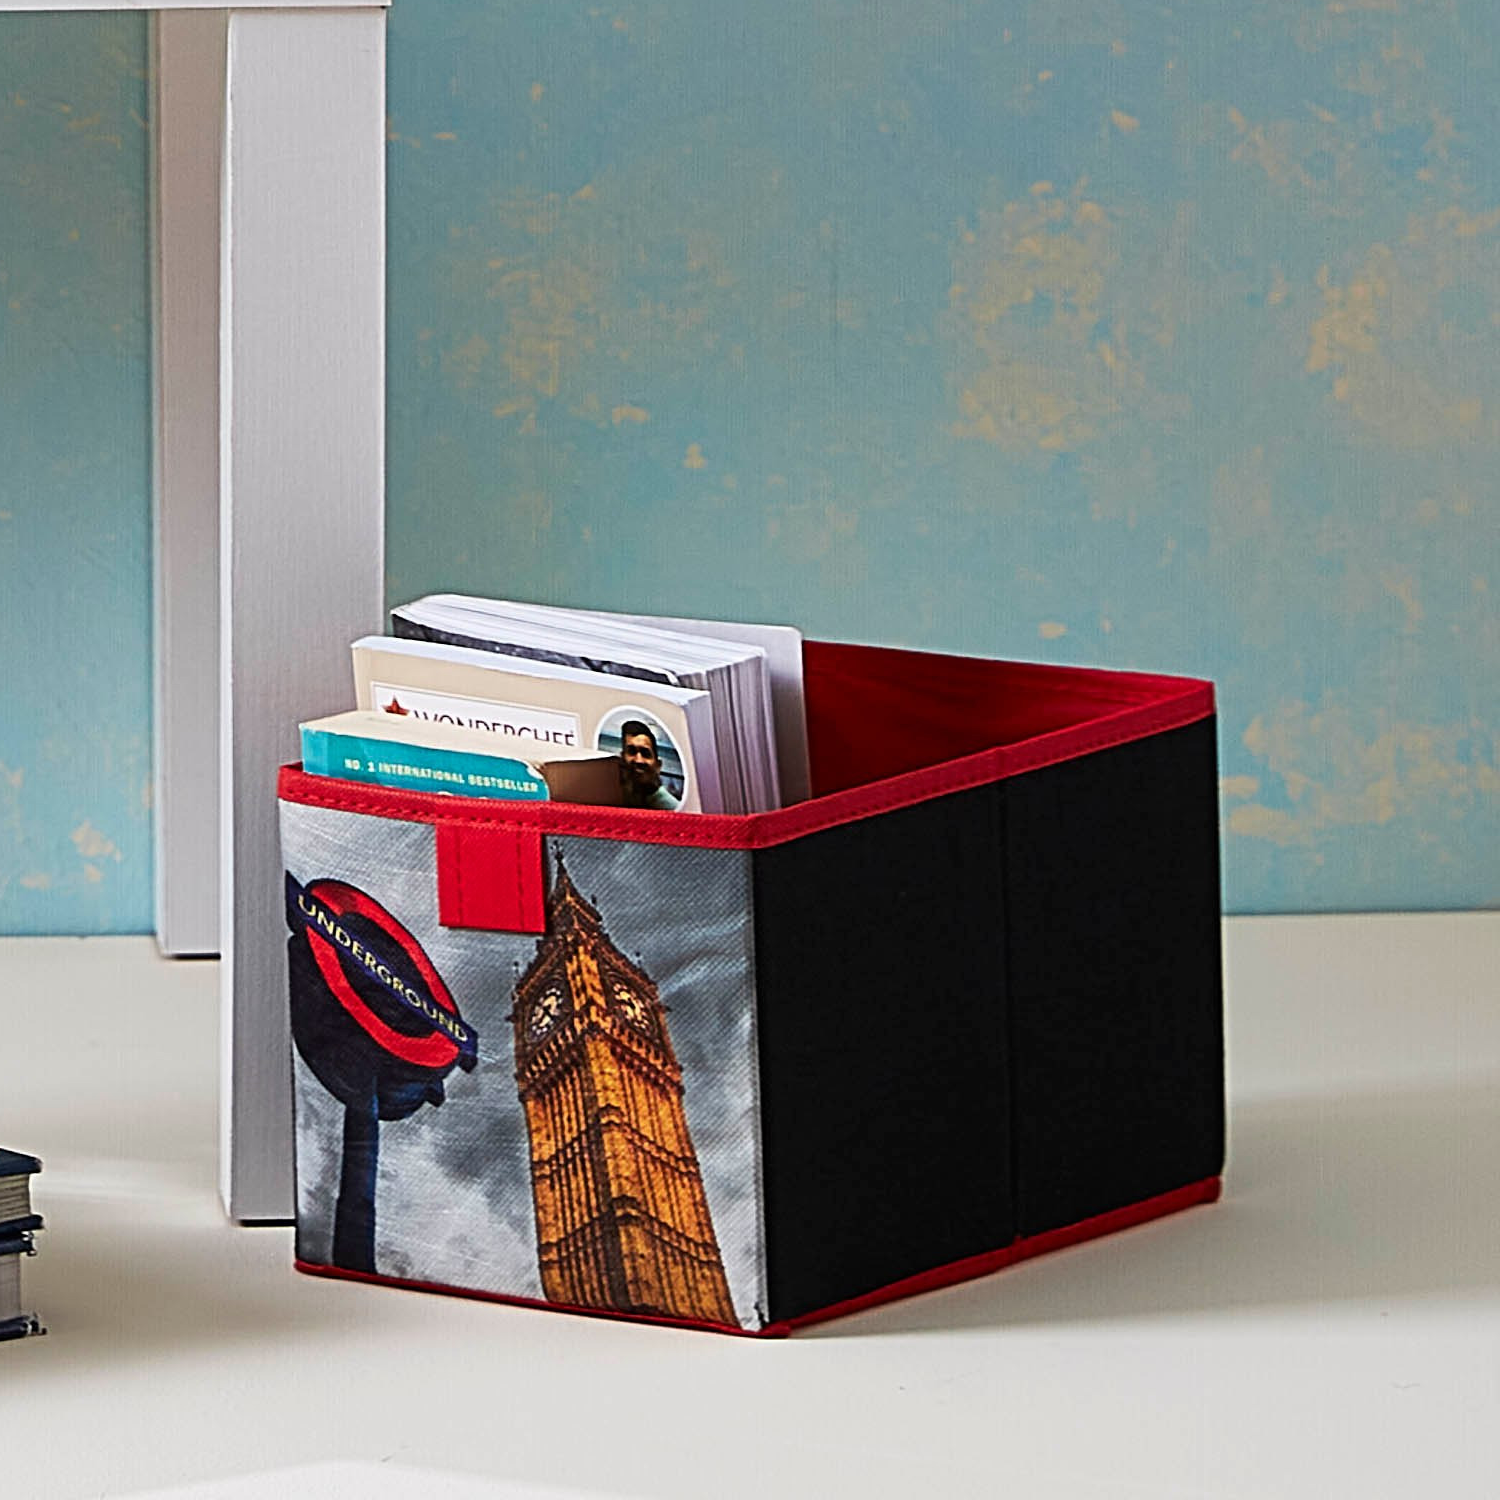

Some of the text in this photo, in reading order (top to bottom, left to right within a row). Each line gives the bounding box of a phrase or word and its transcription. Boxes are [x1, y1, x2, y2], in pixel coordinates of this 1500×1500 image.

[367, 761, 375, 773] 1
[378, 761, 465, 785] INTERNATIONAL
[467, 774, 539, 793] BESTSELLER
[298, 893, 468, 1042] UNDERGROUND
